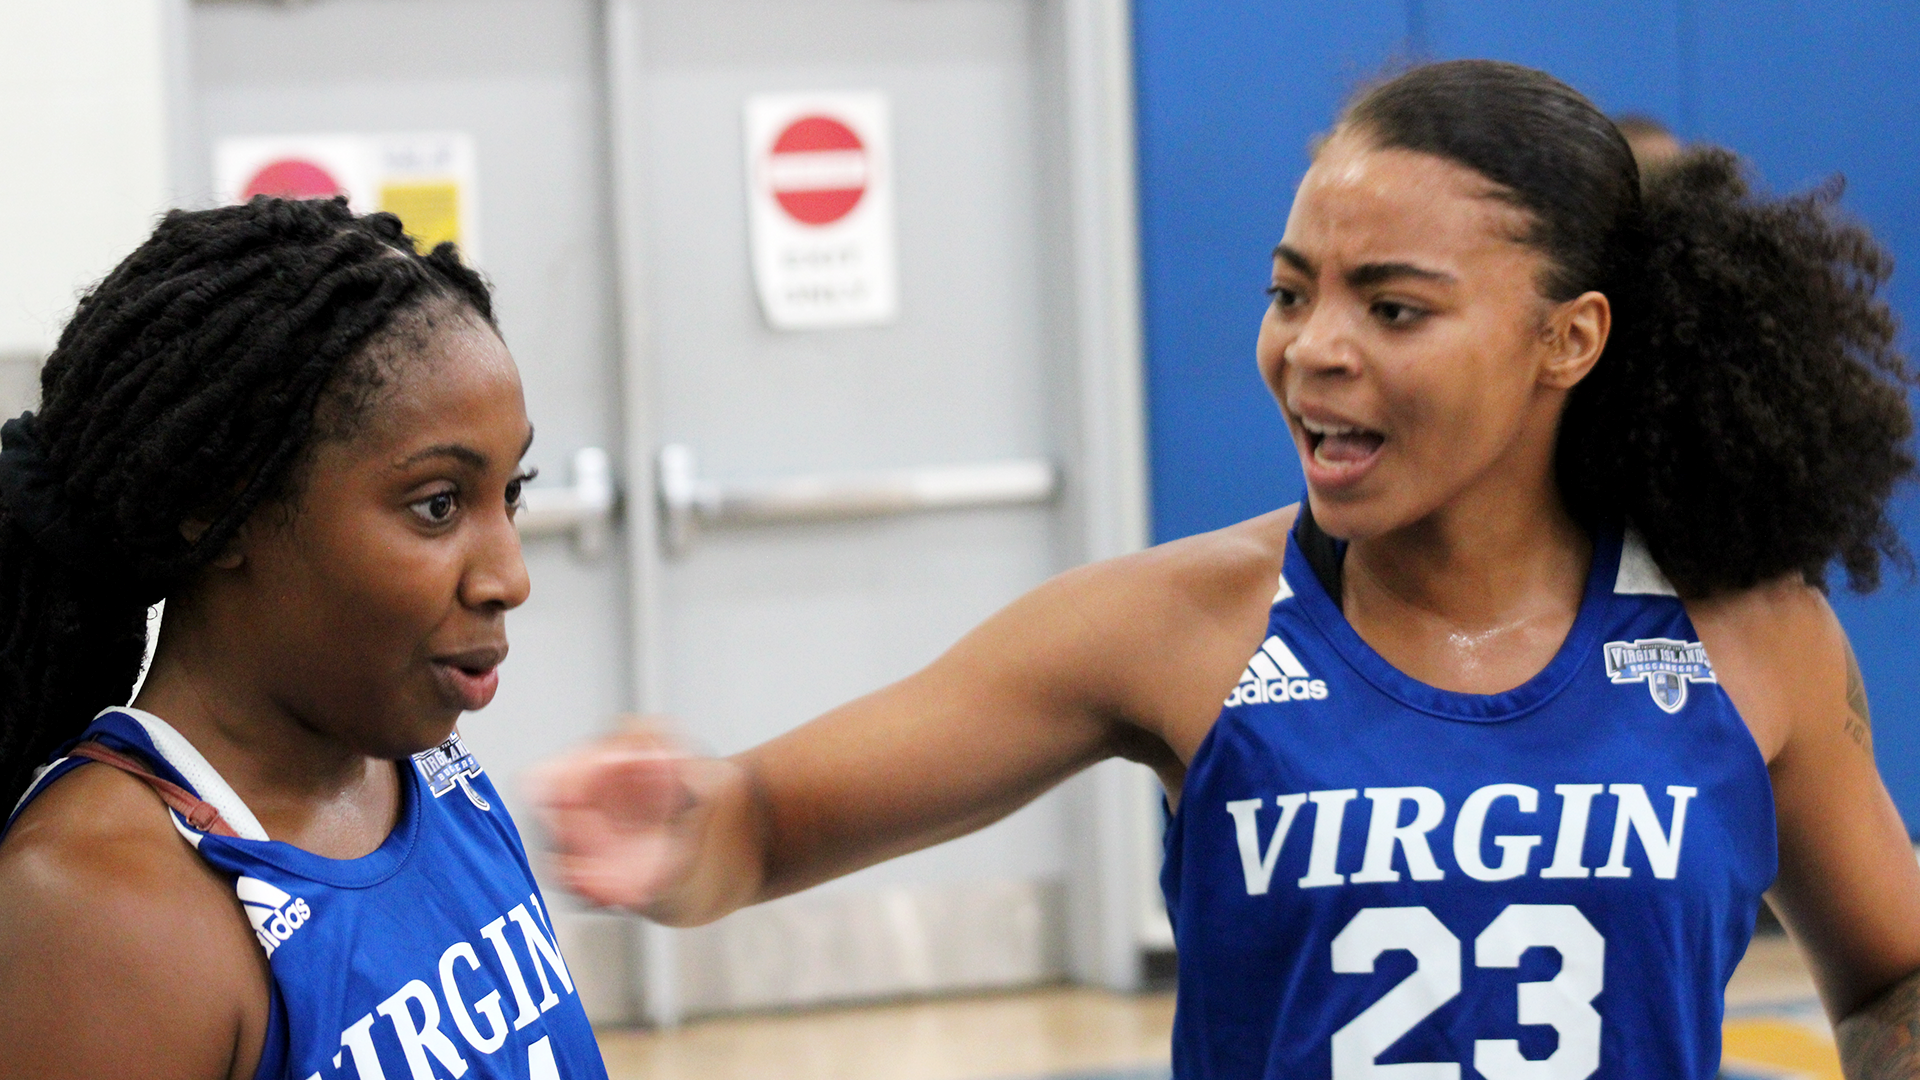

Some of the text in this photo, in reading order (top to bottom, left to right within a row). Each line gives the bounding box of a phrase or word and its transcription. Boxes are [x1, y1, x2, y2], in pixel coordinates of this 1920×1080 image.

[1611, 647, 1658, 668] VIRGIN
[1630, 662, 1699, 673] BUCCANEERS
[1226, 783, 1698, 896] VIRGIN
[256, 897, 311, 960] idas
[305, 892, 575, 1080] IRGIN
[1331, 904, 1605, 1080] 23
